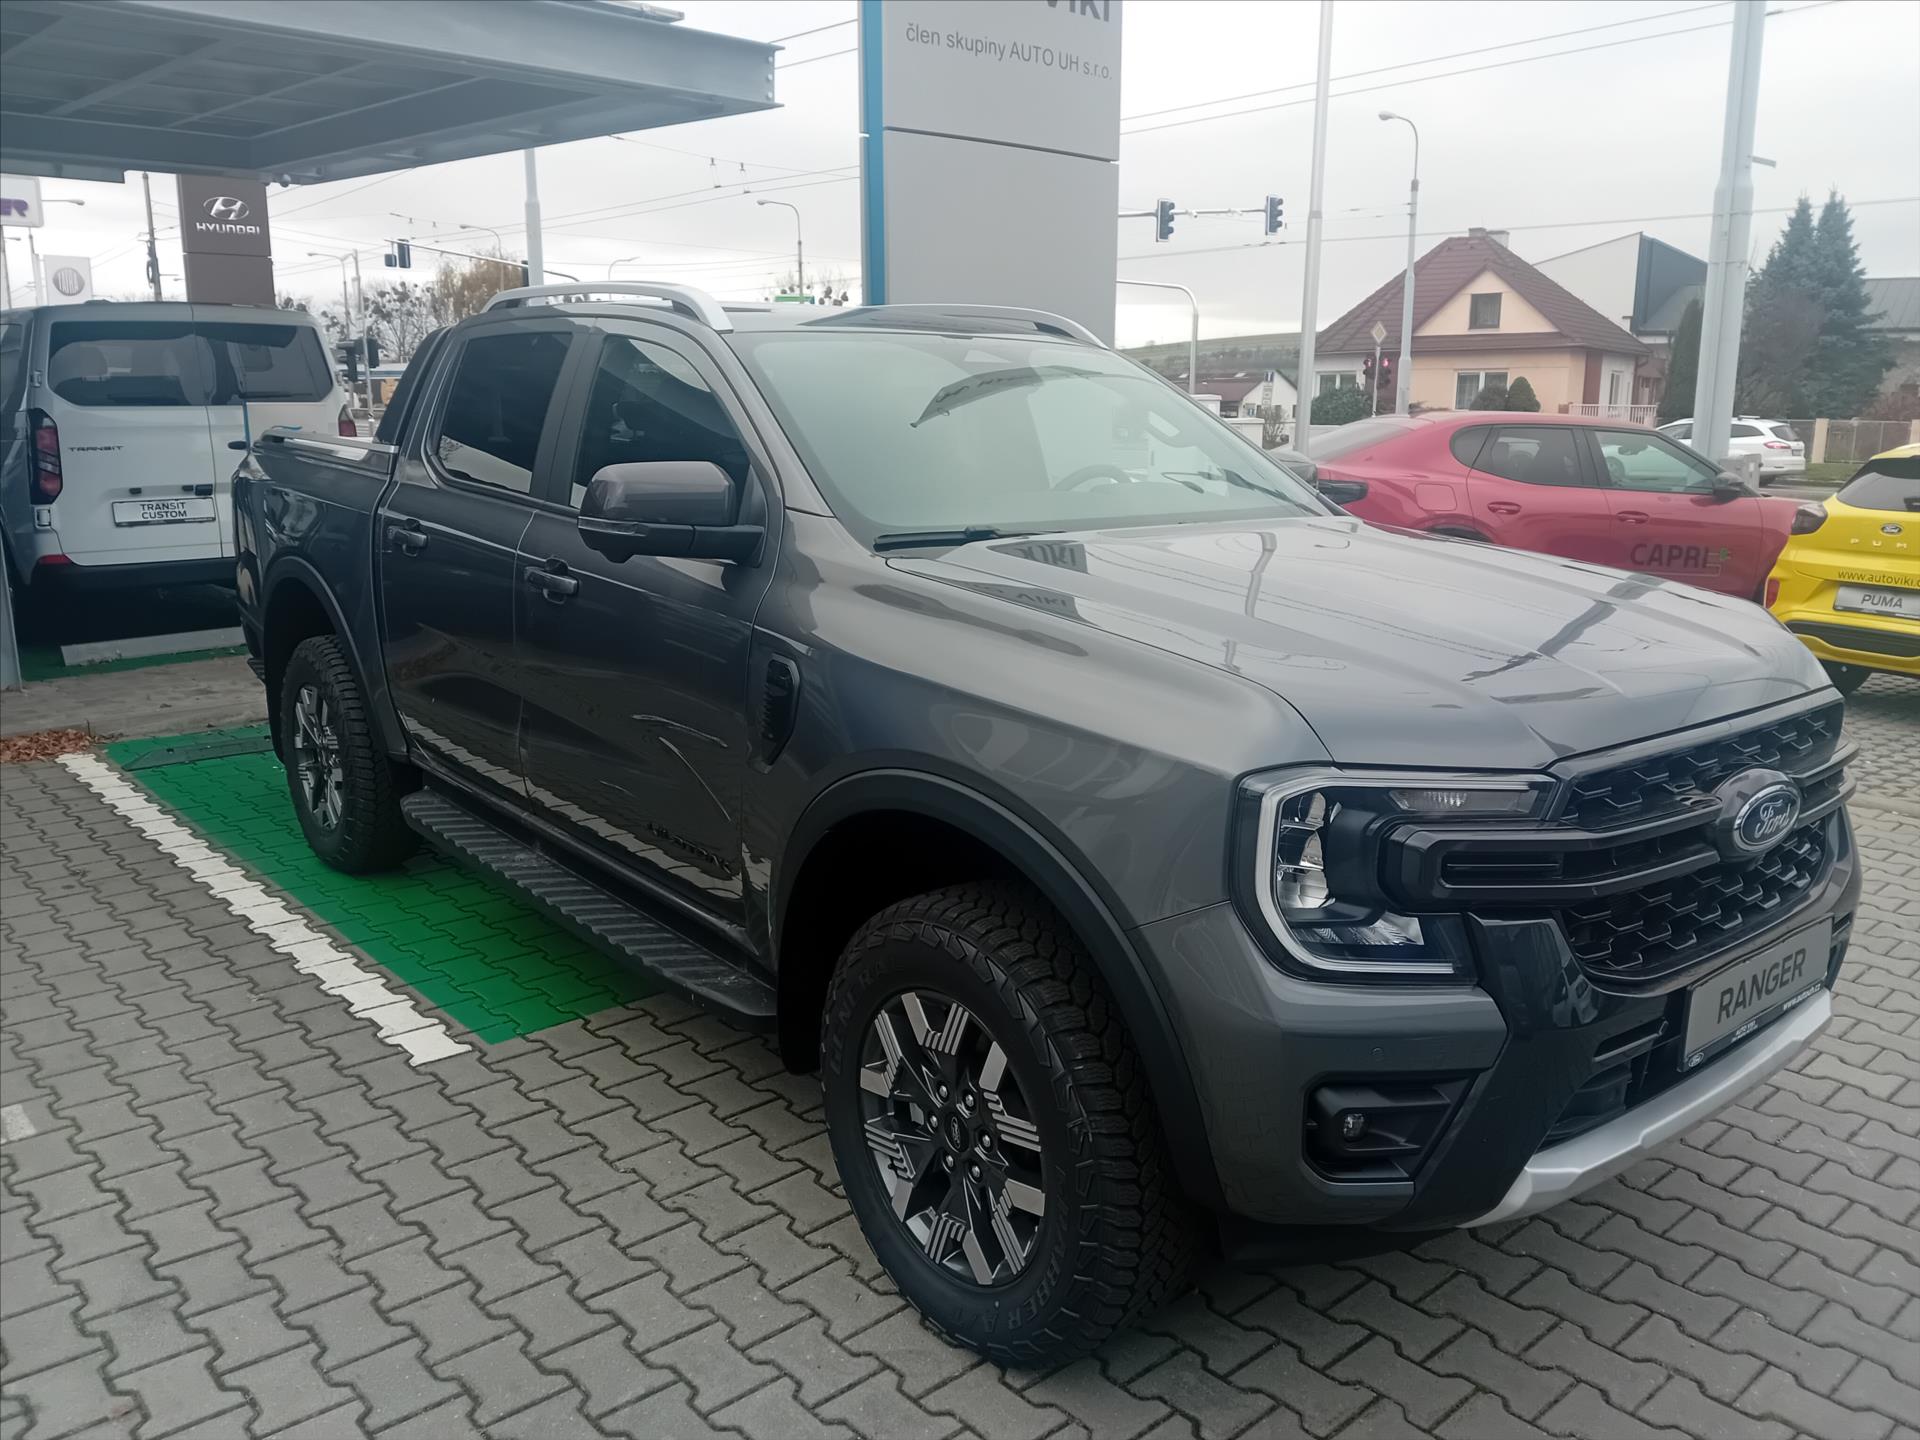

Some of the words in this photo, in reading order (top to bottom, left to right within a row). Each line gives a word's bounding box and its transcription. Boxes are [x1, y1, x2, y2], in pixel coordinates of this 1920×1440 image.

[906, 22, 940, 46] člen
[946, 32, 1006, 61] skupiny
[1009, 41, 1055, 66] AUTO
[1058, 53, 1079, 72] UH
[1083, 61, 1113, 80] s.r.o.
[196, 222, 260, 235] HYUNDAI
[140, 502, 186, 511] TRANSIT
[142, 511, 187, 519] CUSTOM
[1630, 543, 1709, 570] CAPRI
[1861, 594, 1903, 608] PUMA
[1754, 799, 1791, 839] Ford
[1717, 947, 1806, 1024] RANGER
